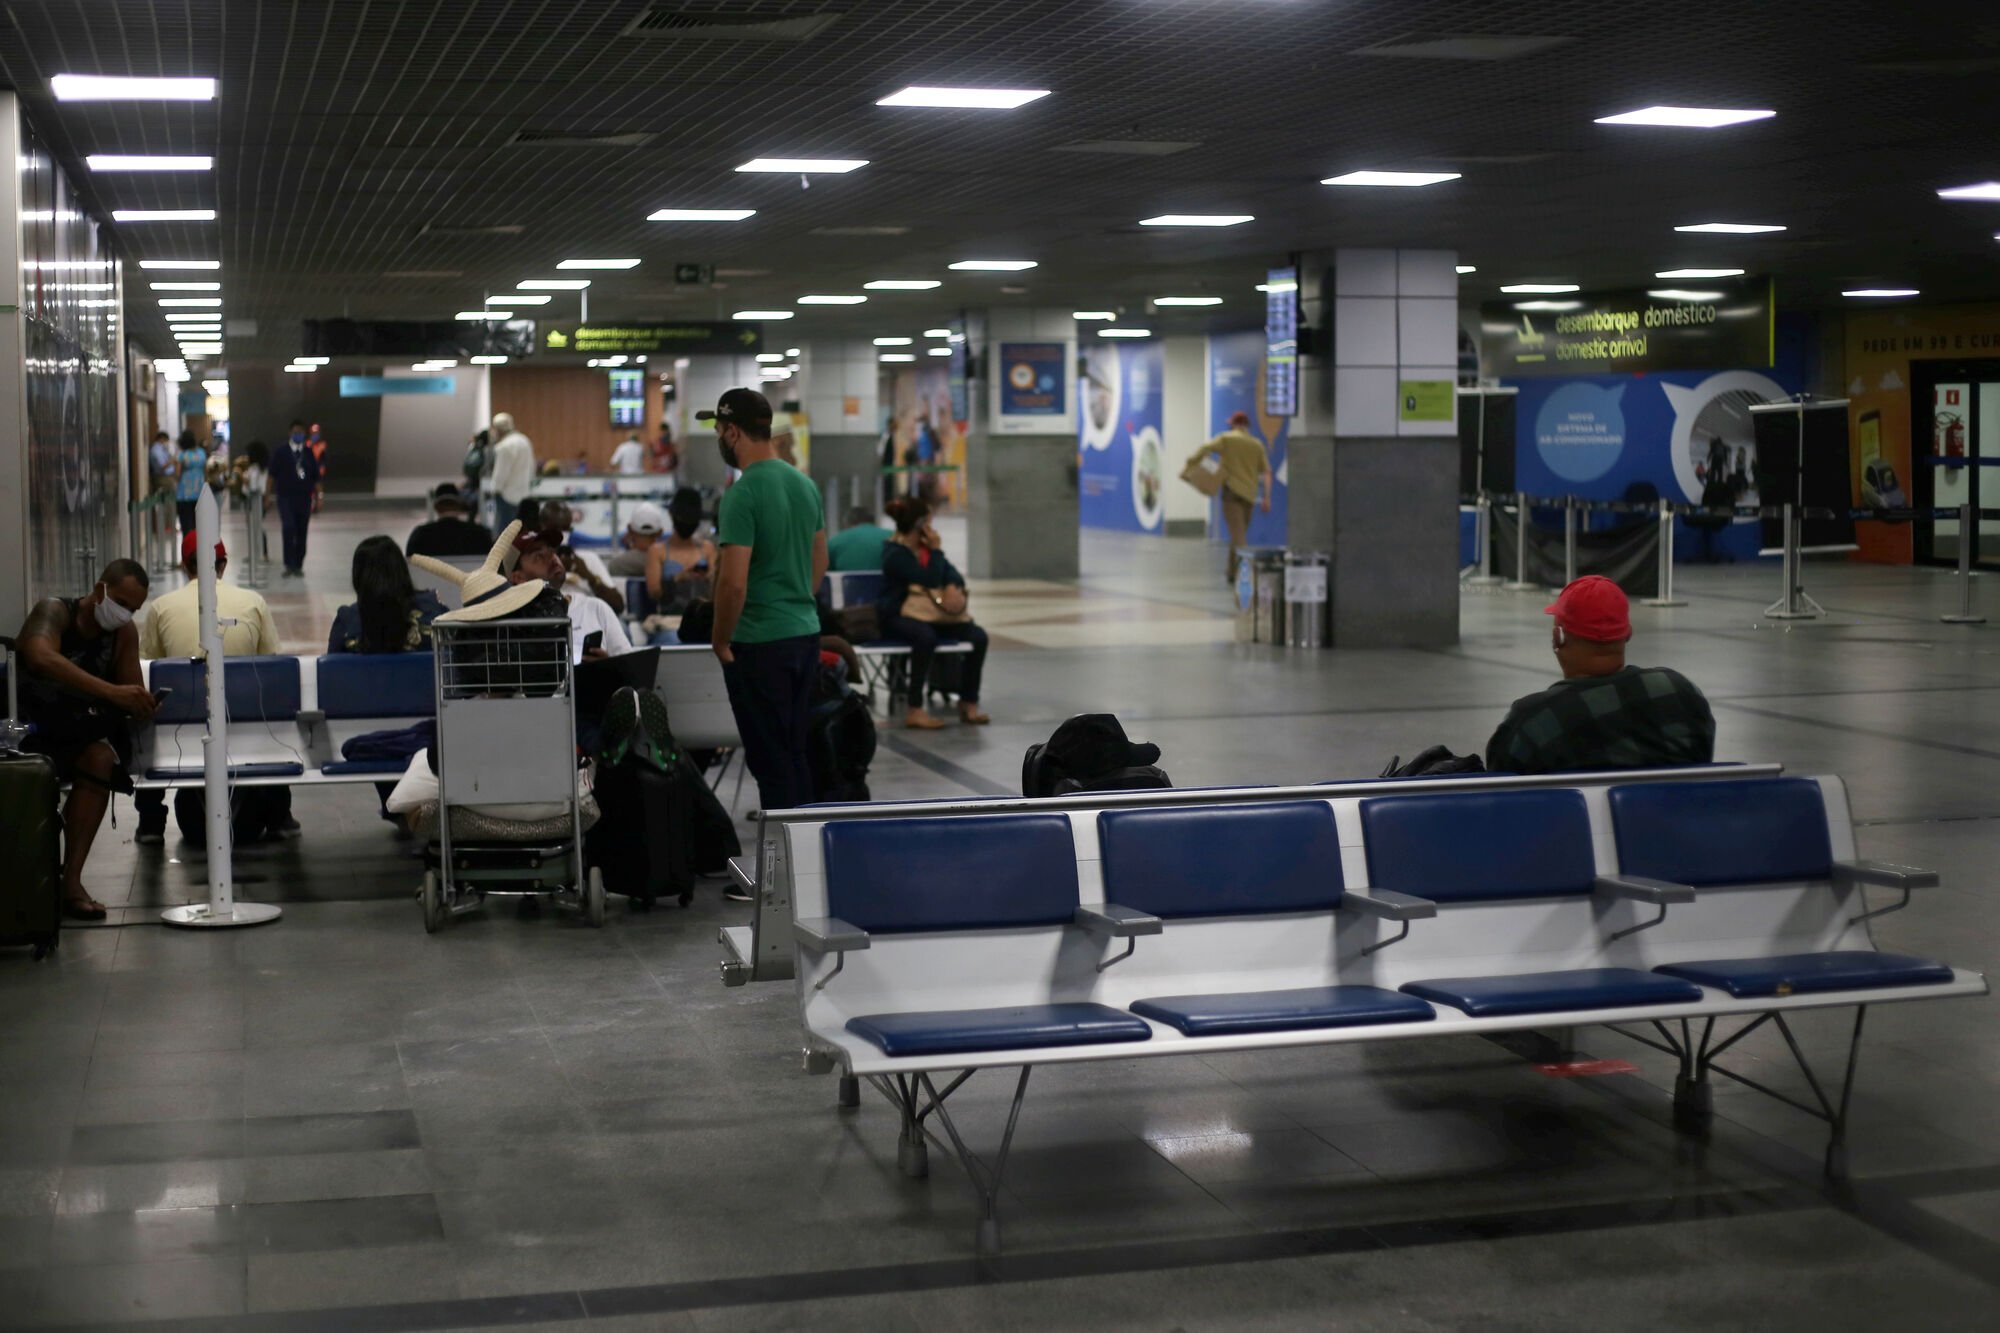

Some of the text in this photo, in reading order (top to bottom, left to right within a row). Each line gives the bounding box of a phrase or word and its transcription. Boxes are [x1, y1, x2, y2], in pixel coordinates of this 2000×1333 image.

[1555, 303, 1716, 335] desembarque doméstico
[1556, 335, 1647, 360] domestic arrival
[1863, 337, 1897, 352] PEDE
[1903, 335, 1923, 350] UM
[1955, 335, 1963, 349] E
